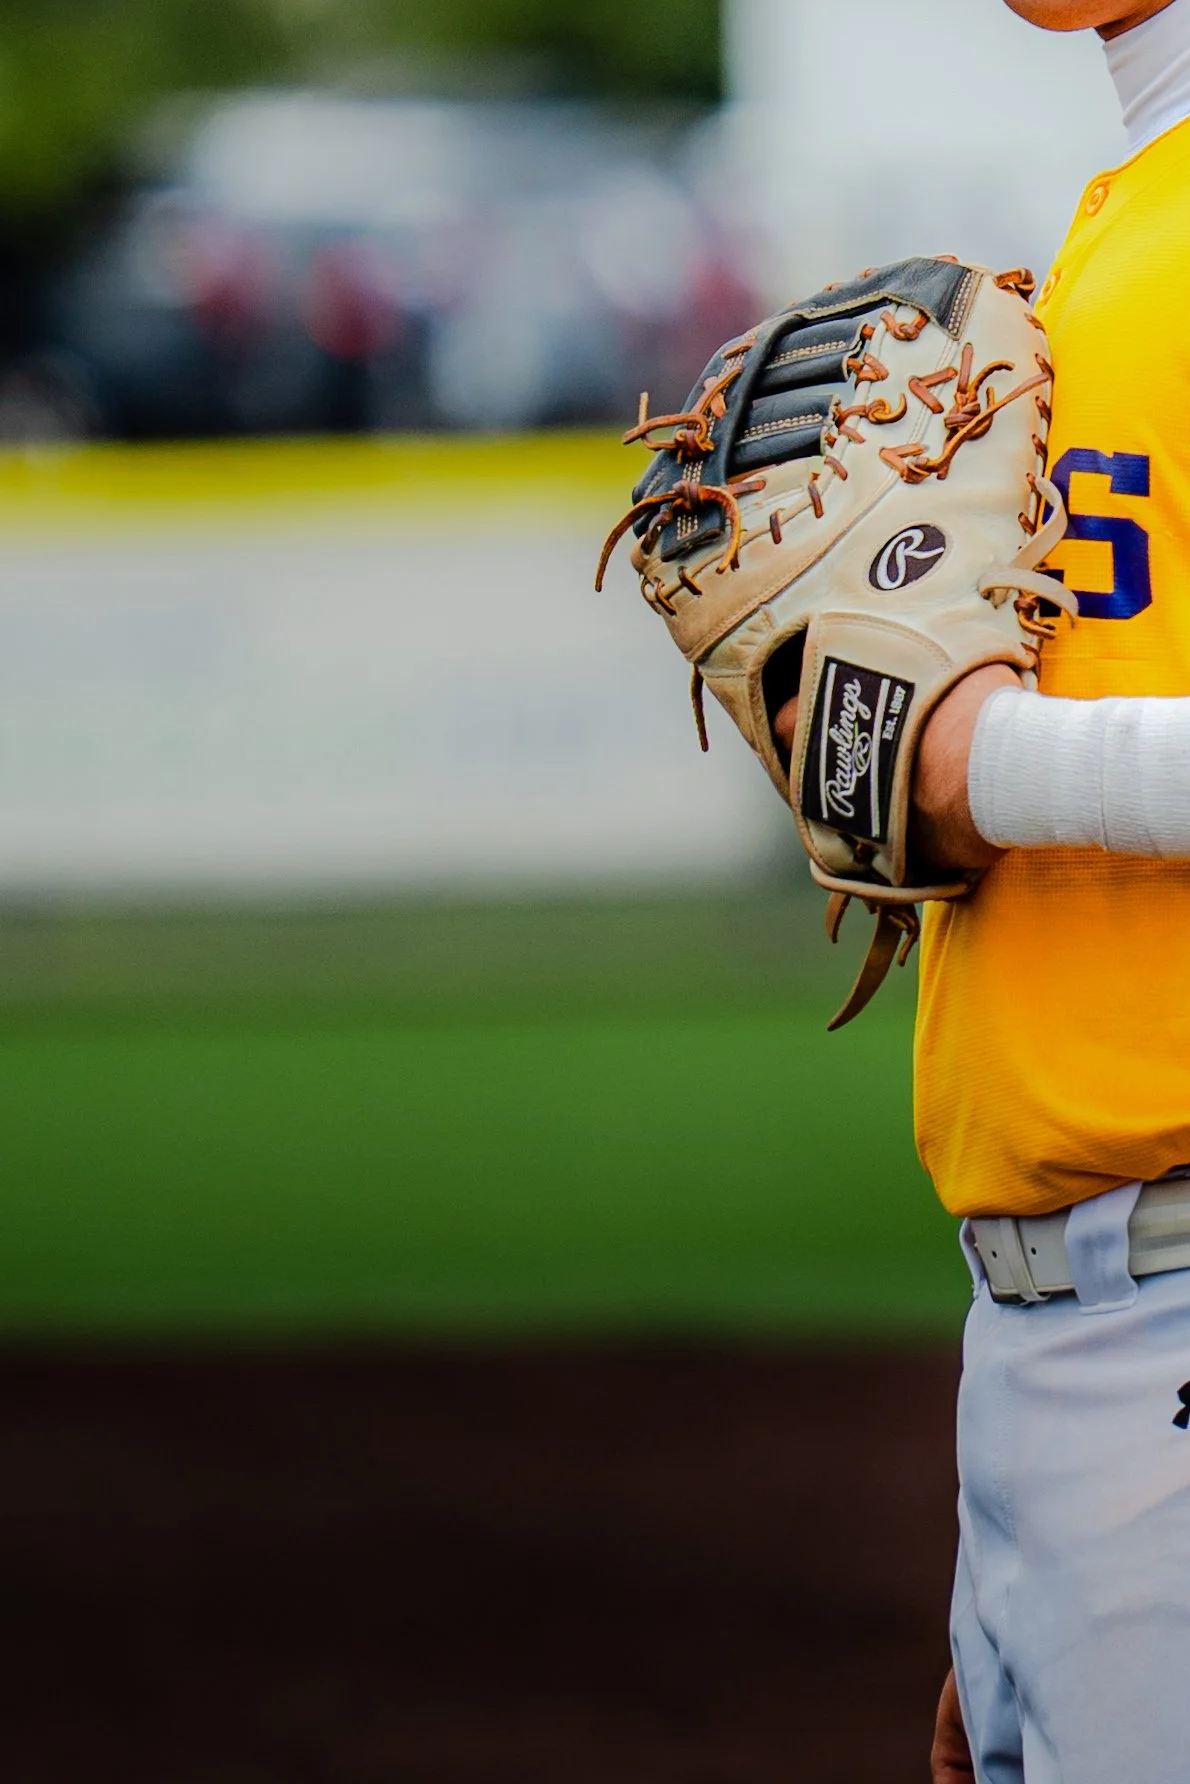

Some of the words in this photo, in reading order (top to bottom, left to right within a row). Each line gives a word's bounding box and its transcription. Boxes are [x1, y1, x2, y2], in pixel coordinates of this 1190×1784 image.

[876, 528, 945, 590] R
[1039, 447, 1153, 621] S
[825, 677, 872, 817] Rawlings
[881, 715, 899, 742] Est.
